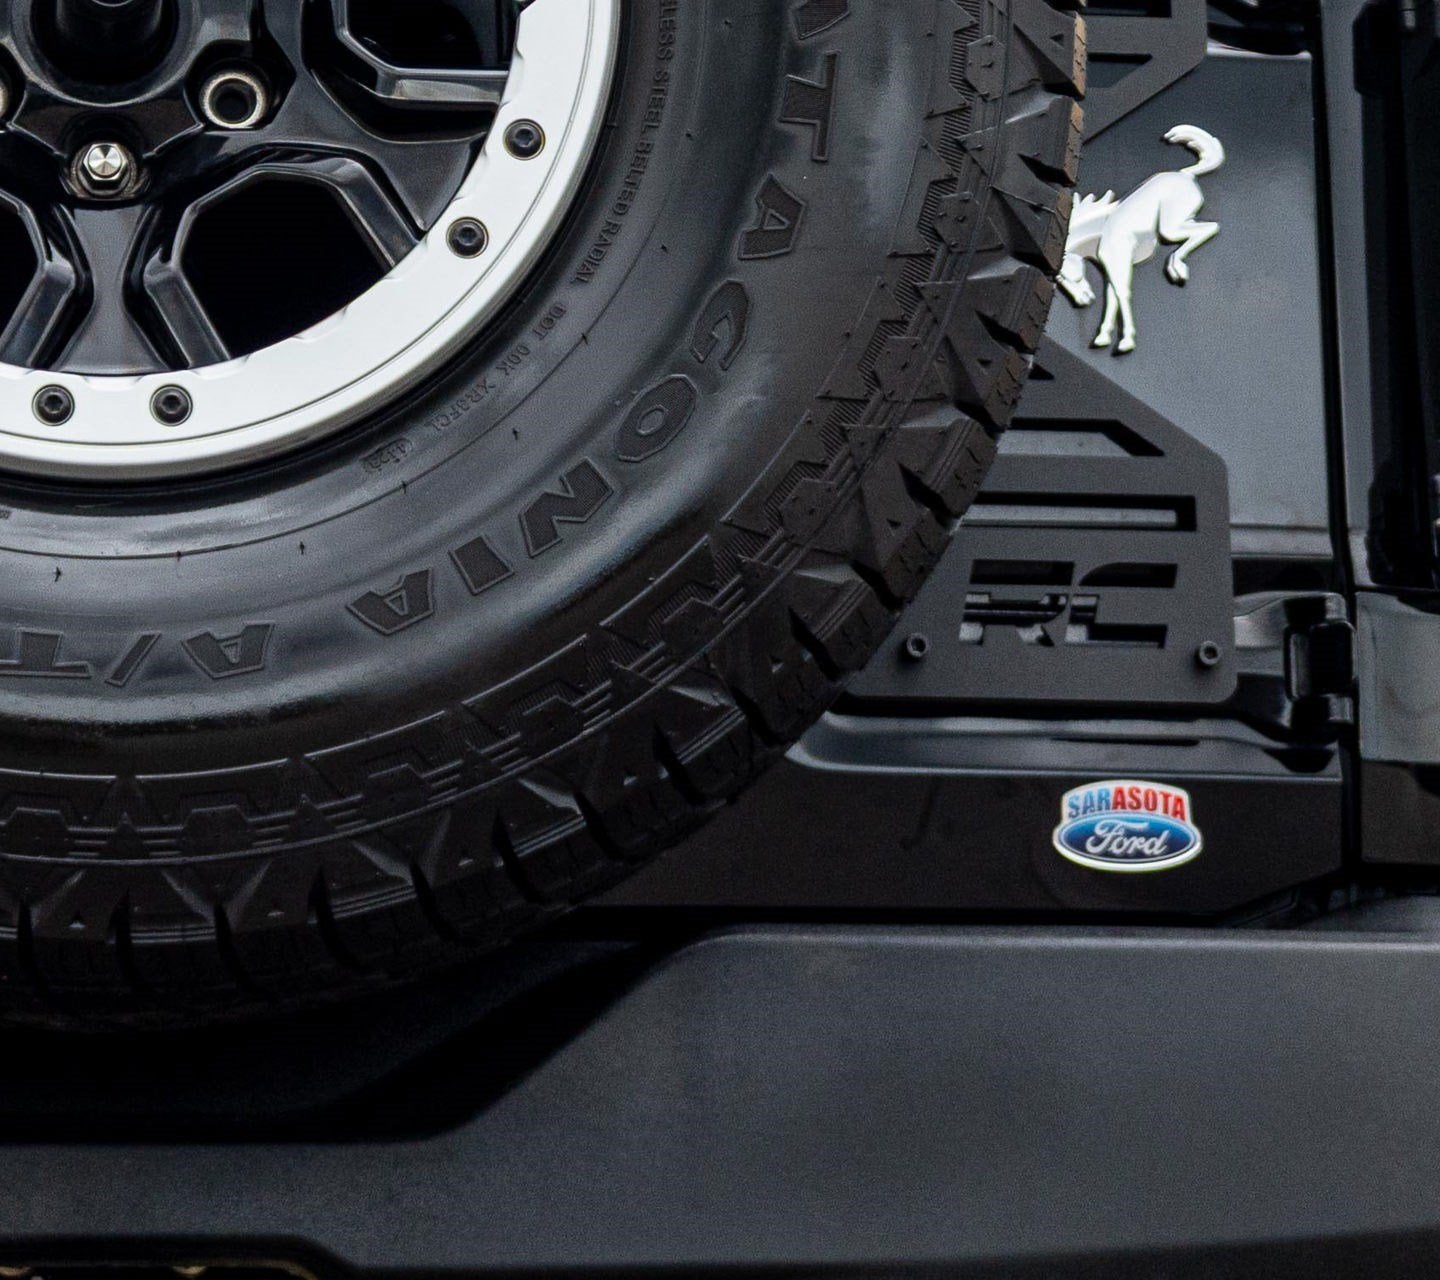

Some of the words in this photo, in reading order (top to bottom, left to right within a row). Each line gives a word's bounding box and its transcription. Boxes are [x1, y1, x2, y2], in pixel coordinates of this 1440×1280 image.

[640, 68, 671, 136] STEEL
[610, 136, 654, 219] BELTED
[568, 215, 623, 293] RADIAL
[1067, 785, 1187, 821] SARASOTA
[1085, 817, 1173, 856] Ford
